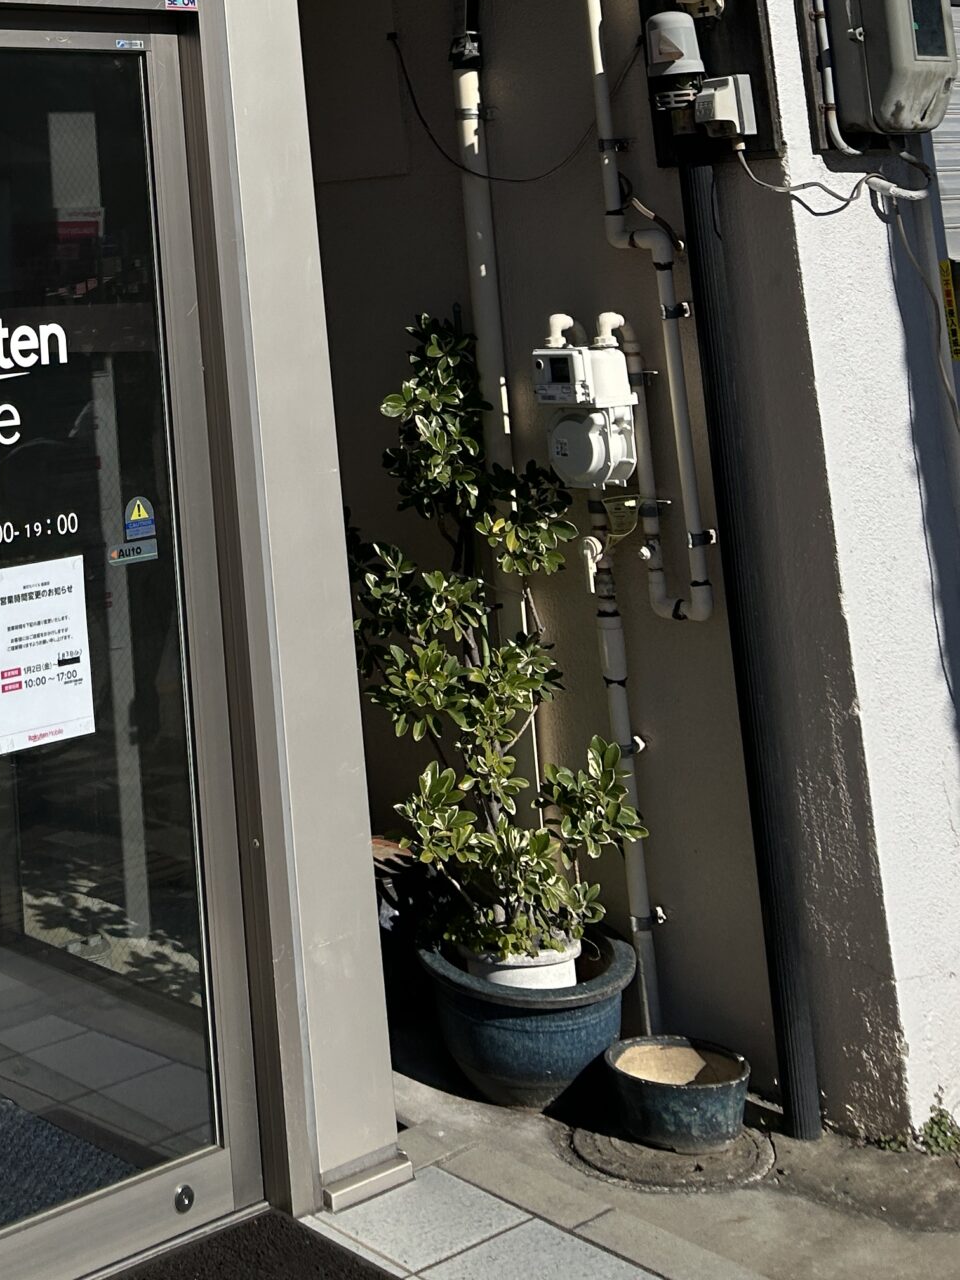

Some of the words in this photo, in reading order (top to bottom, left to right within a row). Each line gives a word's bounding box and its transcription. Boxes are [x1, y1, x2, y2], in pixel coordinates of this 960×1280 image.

[119, 547, 142, 559] Auto
[0, 584, 73, 607] 営業時間変更のお知らせ
